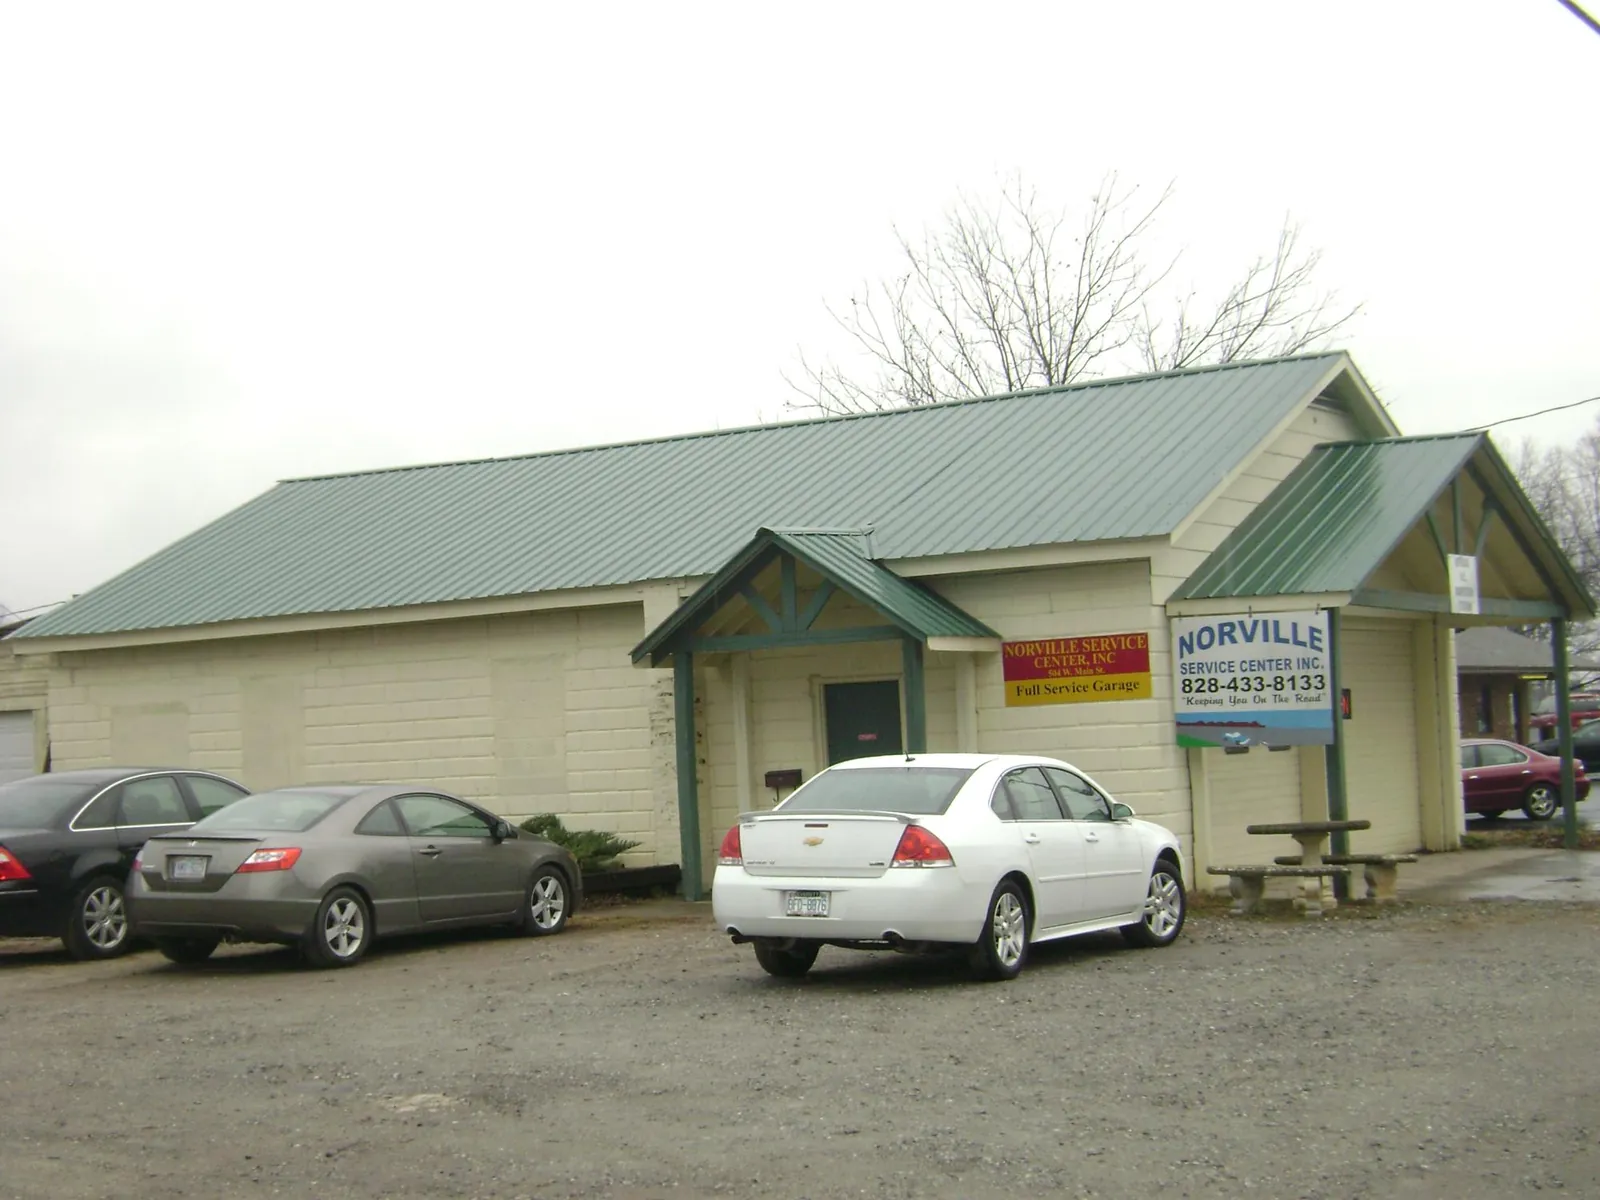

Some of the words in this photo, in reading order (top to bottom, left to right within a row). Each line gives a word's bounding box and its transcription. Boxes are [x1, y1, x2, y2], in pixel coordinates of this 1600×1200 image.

[1004, 640, 1078, 658] NORVILLE
[1082, 635, 1147, 653] SERVICE
[1179, 619, 1323, 659] NORVILLE
[1034, 654, 1090, 669] CENTER,
[1093, 652, 1116, 665] INC
[1180, 660, 1235, 675] SERVICE
[1239, 659, 1292, 673] CENTER
[1297, 657, 1324, 670] INC.
[1075, 667, 1094, 676] Main
[1016, 684, 1041, 697] Full
[1044, 682, 1089, 695] Service
[1092, 680, 1140, 693] Garage
[1181, 675, 1326, 694] 828-433-8133
[1228, 695, 1248, 707] You
[1253, 695, 1267, 704] On
[1272, 694, 1289, 704] The
